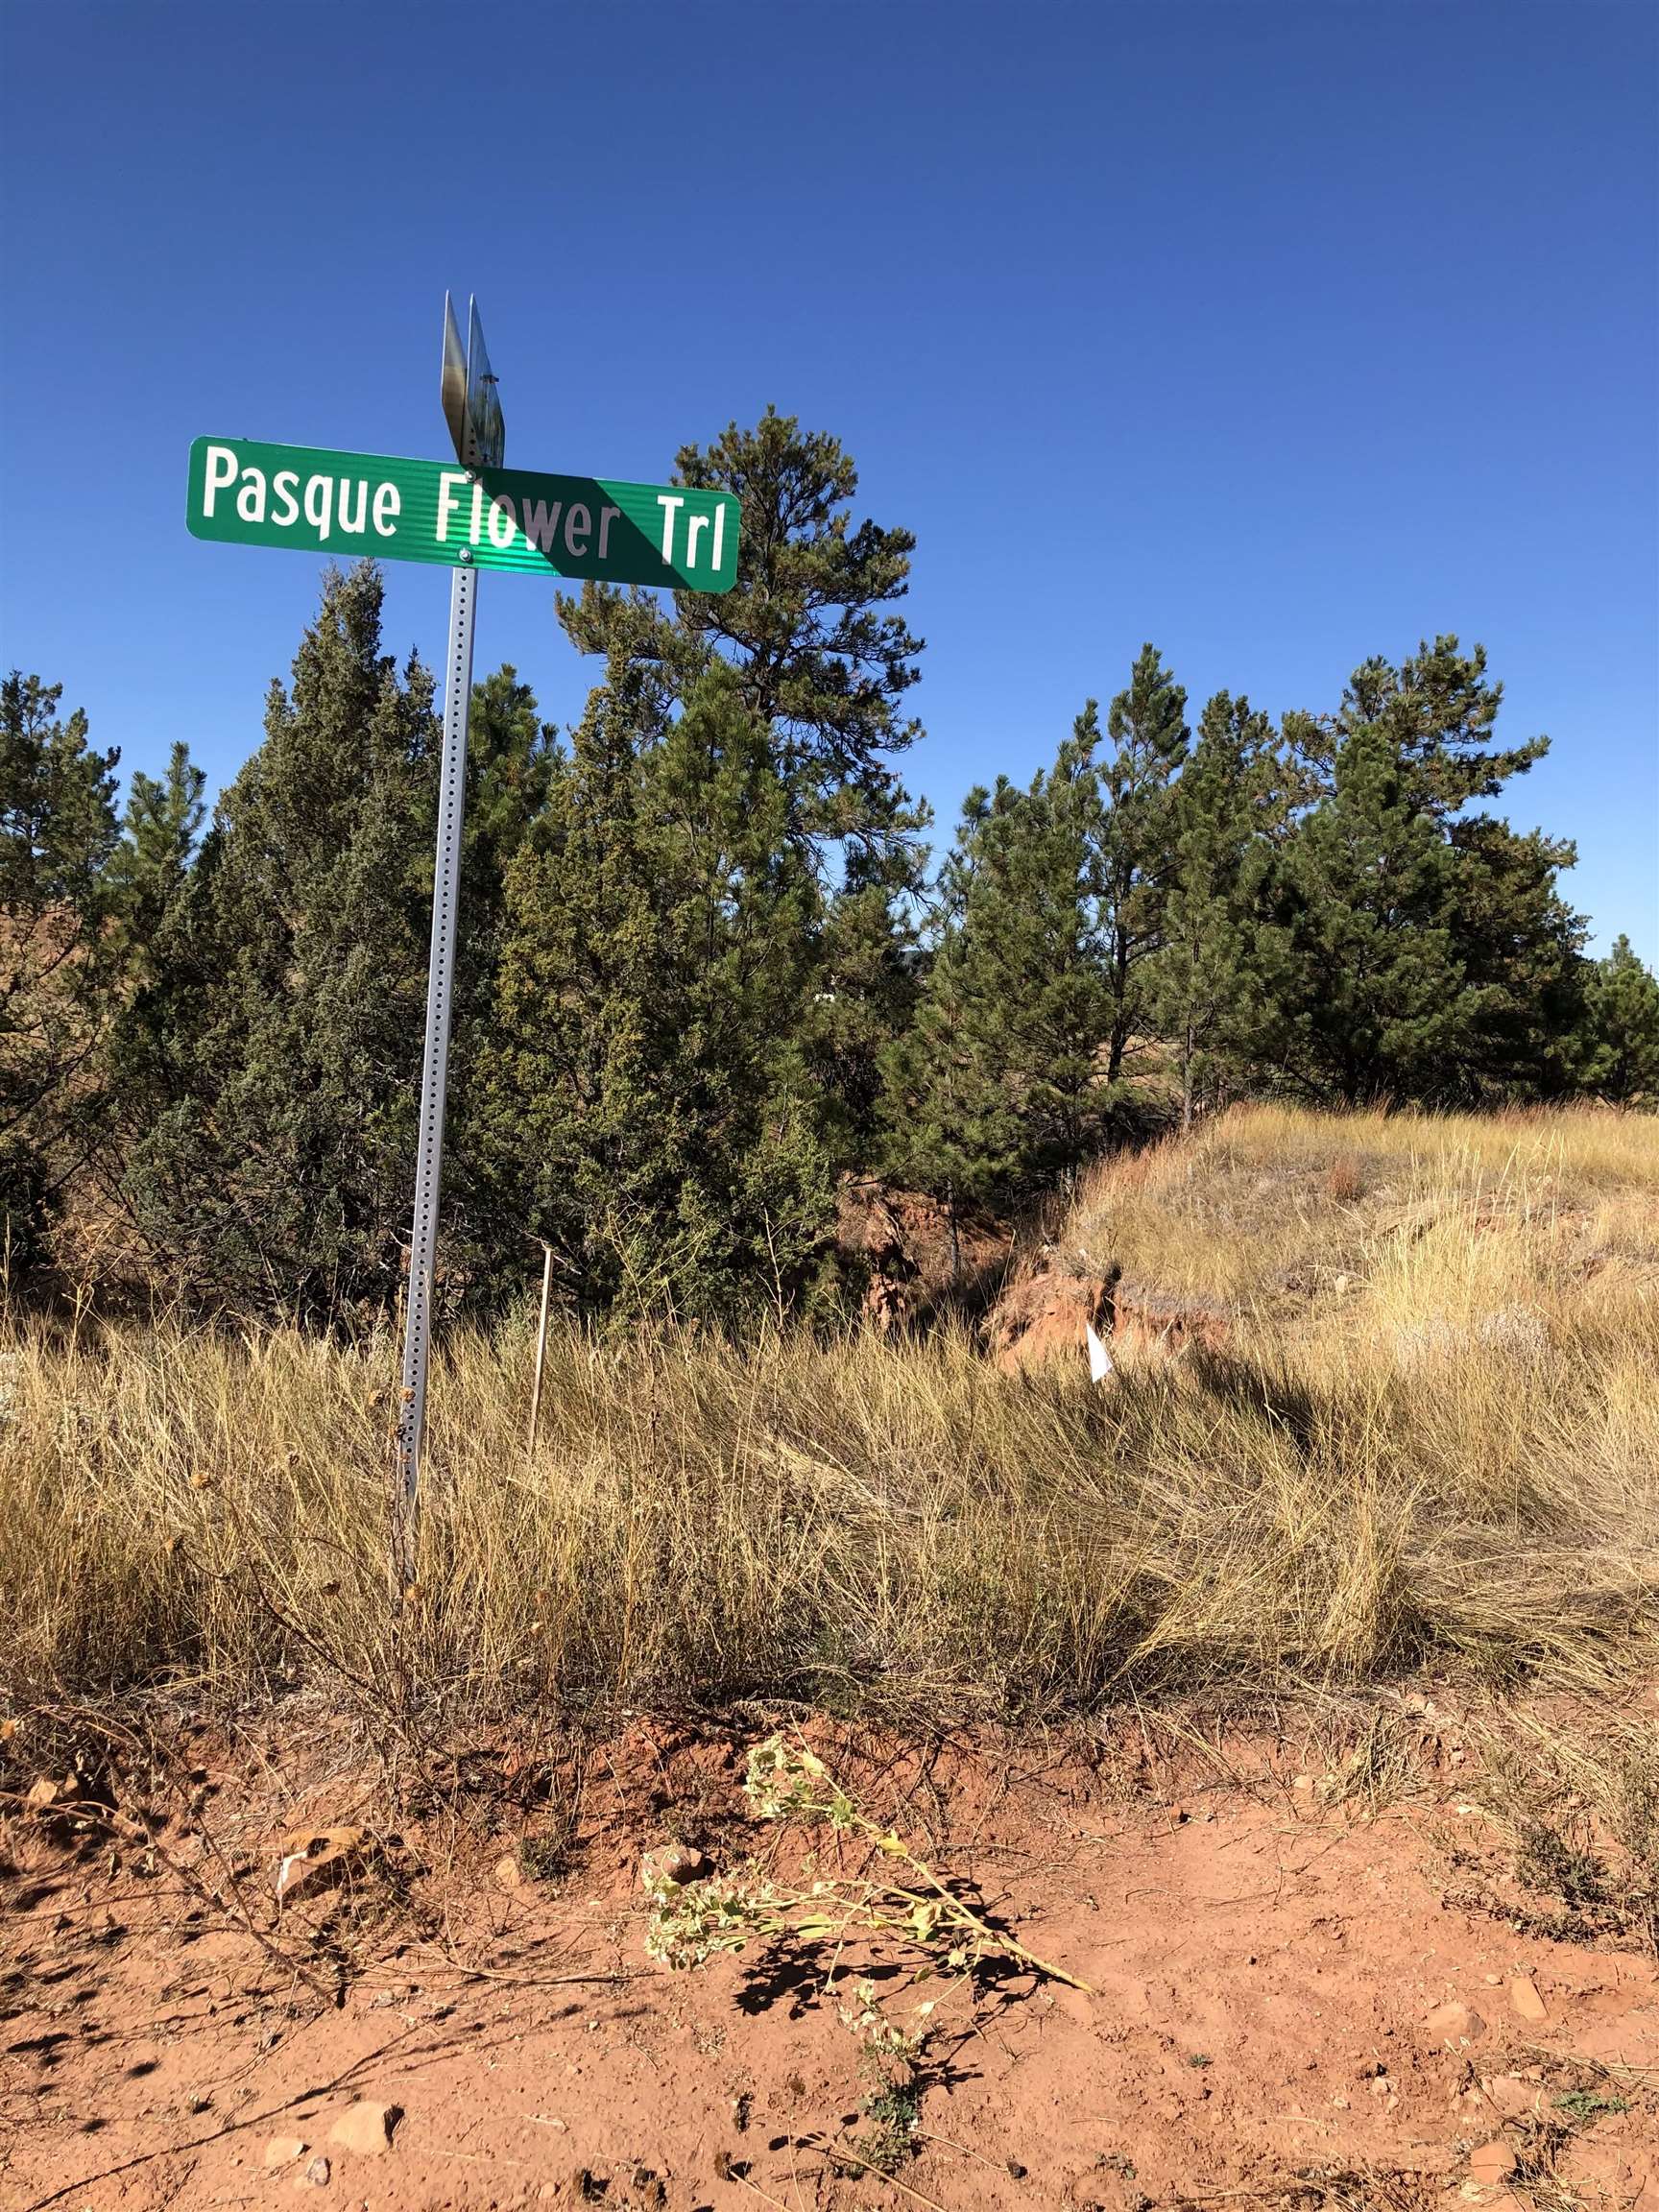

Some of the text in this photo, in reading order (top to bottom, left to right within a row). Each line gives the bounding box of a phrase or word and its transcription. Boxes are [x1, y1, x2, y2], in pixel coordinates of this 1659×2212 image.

[202, 445, 726, 571] Pasque Flower Trl
